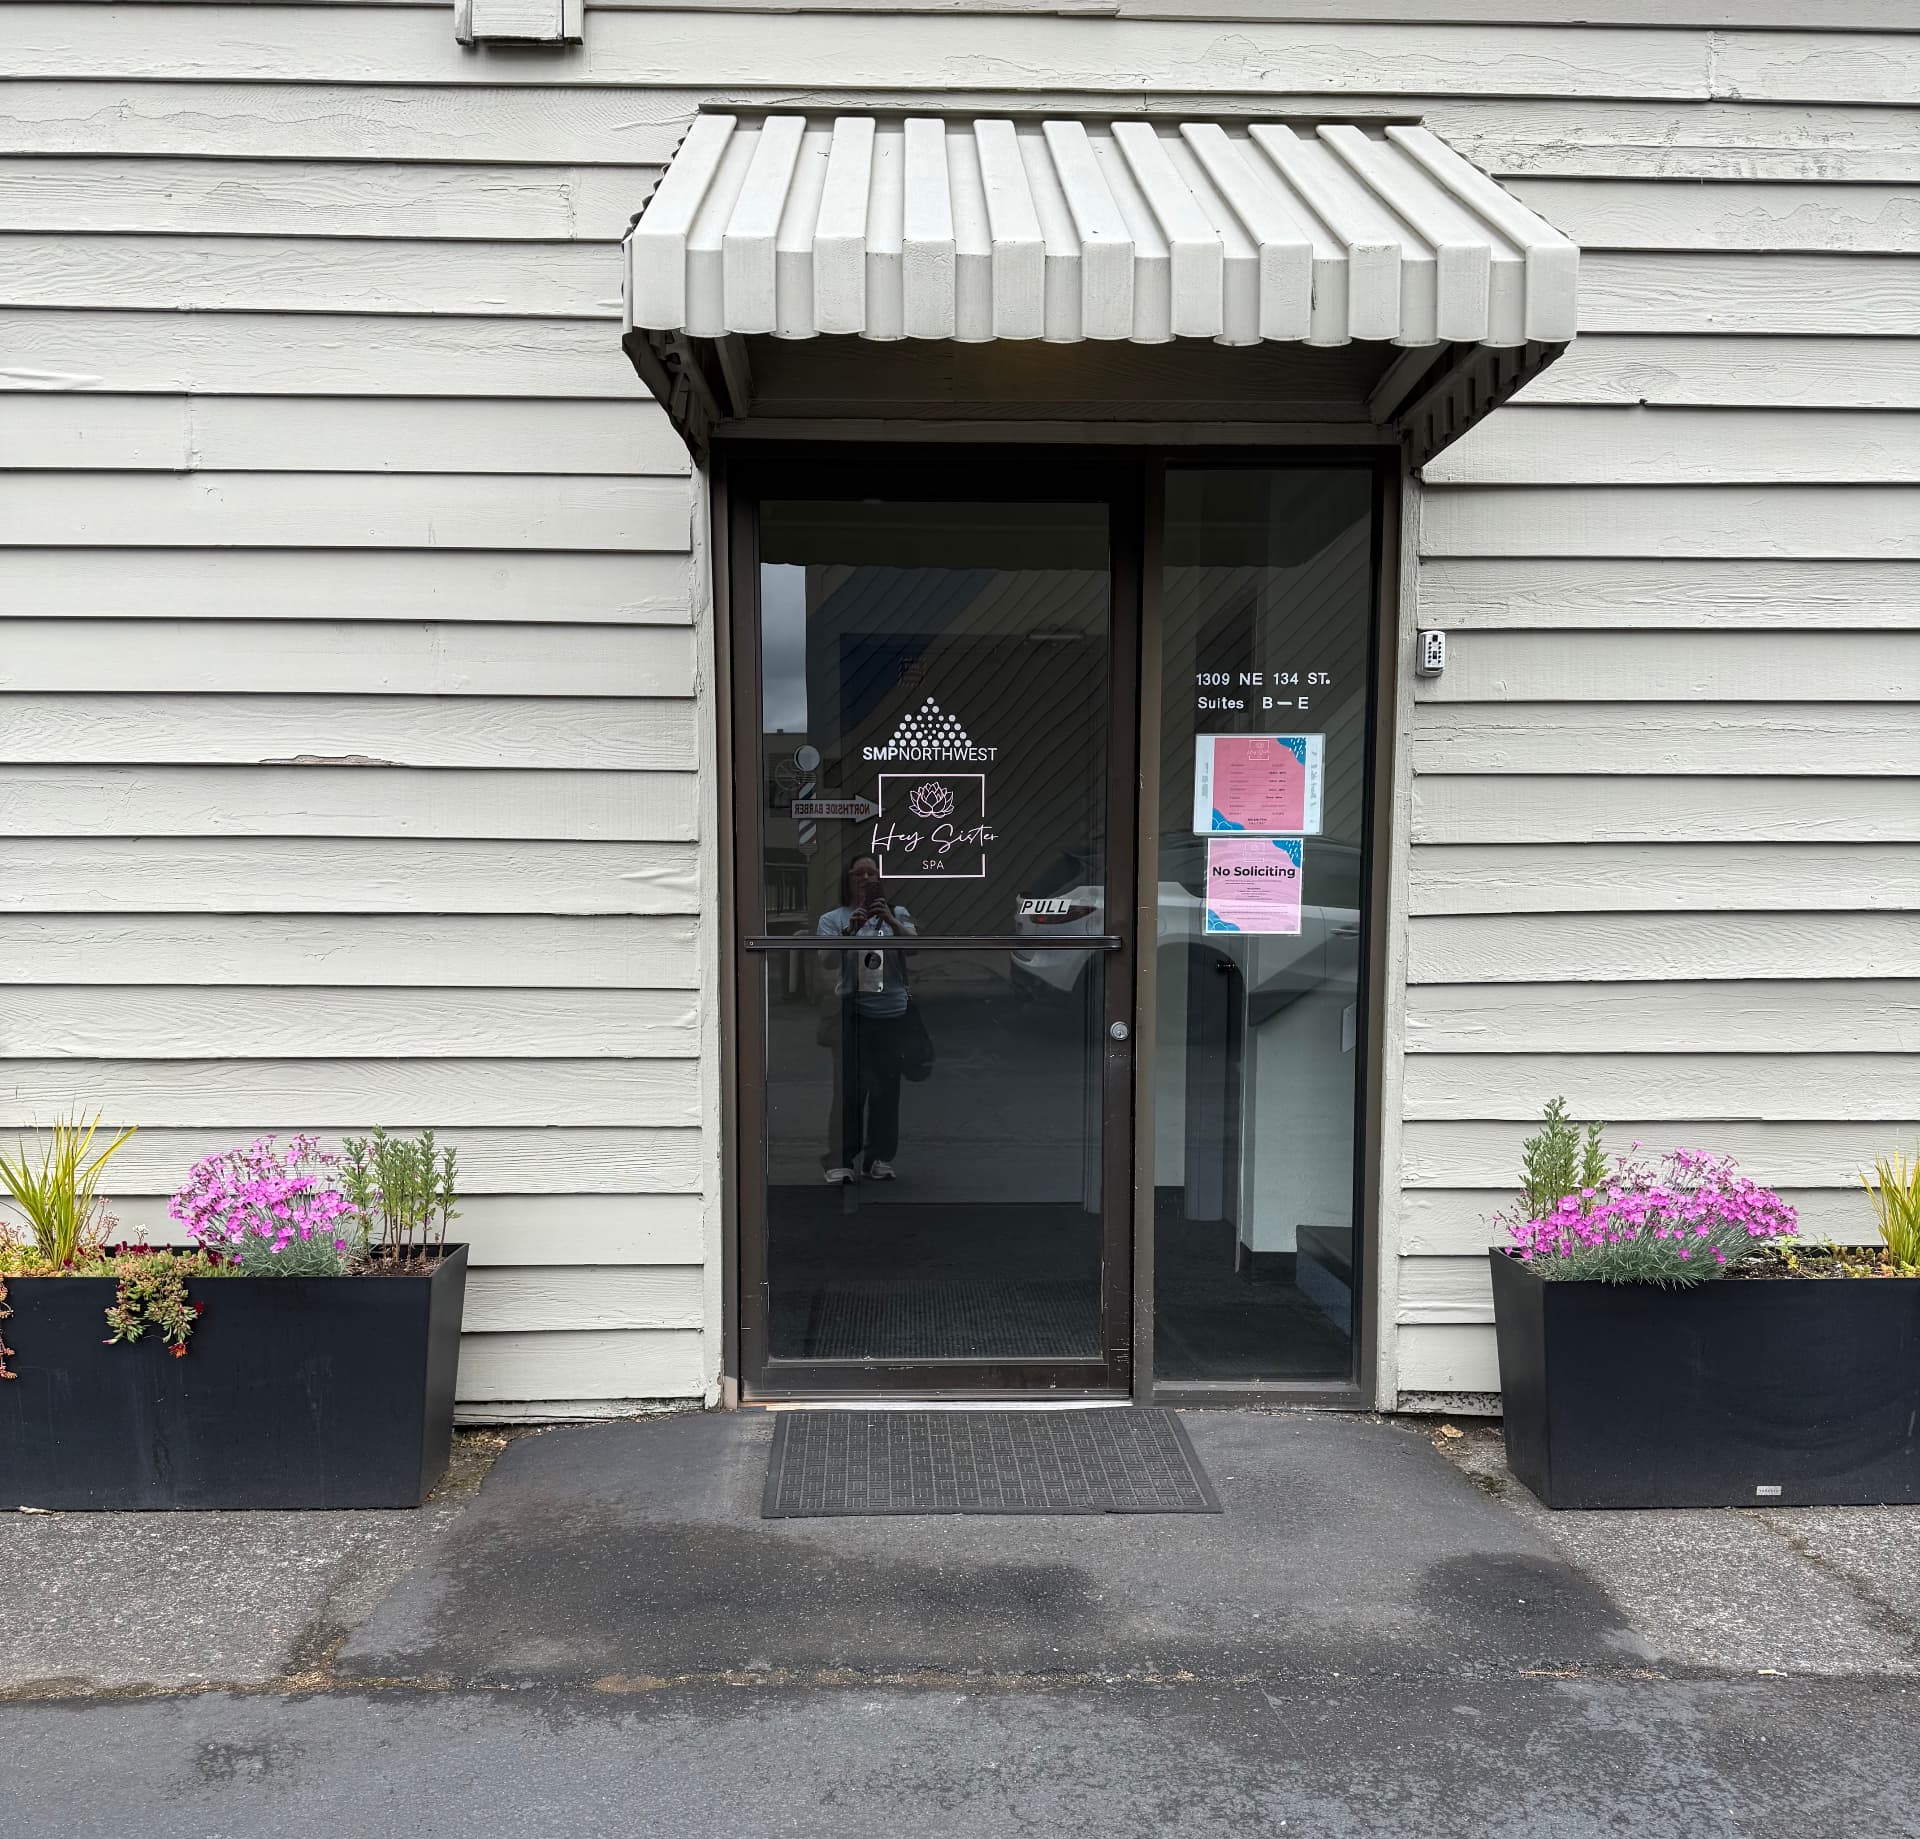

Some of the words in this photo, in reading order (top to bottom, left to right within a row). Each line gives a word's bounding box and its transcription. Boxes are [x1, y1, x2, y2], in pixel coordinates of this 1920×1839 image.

[1196, 672, 1230, 686] 1309
[1239, 672, 1264, 686] NE
[1273, 672, 1299, 686] 134
[1307, 672, 1331, 685] ST.
[1198, 696, 1244, 709] Suites
[1262, 696, 1273, 709] B
[1298, 696, 1309, 709] E
[862, 747, 998, 761] SMPNORTHWEST
[871, 822, 925, 854] Hey
[931, 823, 999, 854] Sister
[922, 860, 945, 870] SPA
[1212, 866, 1231, 877] No
[1233, 865, 1296, 879] Soliciting
[1021, 900, 1067, 914] PULL
